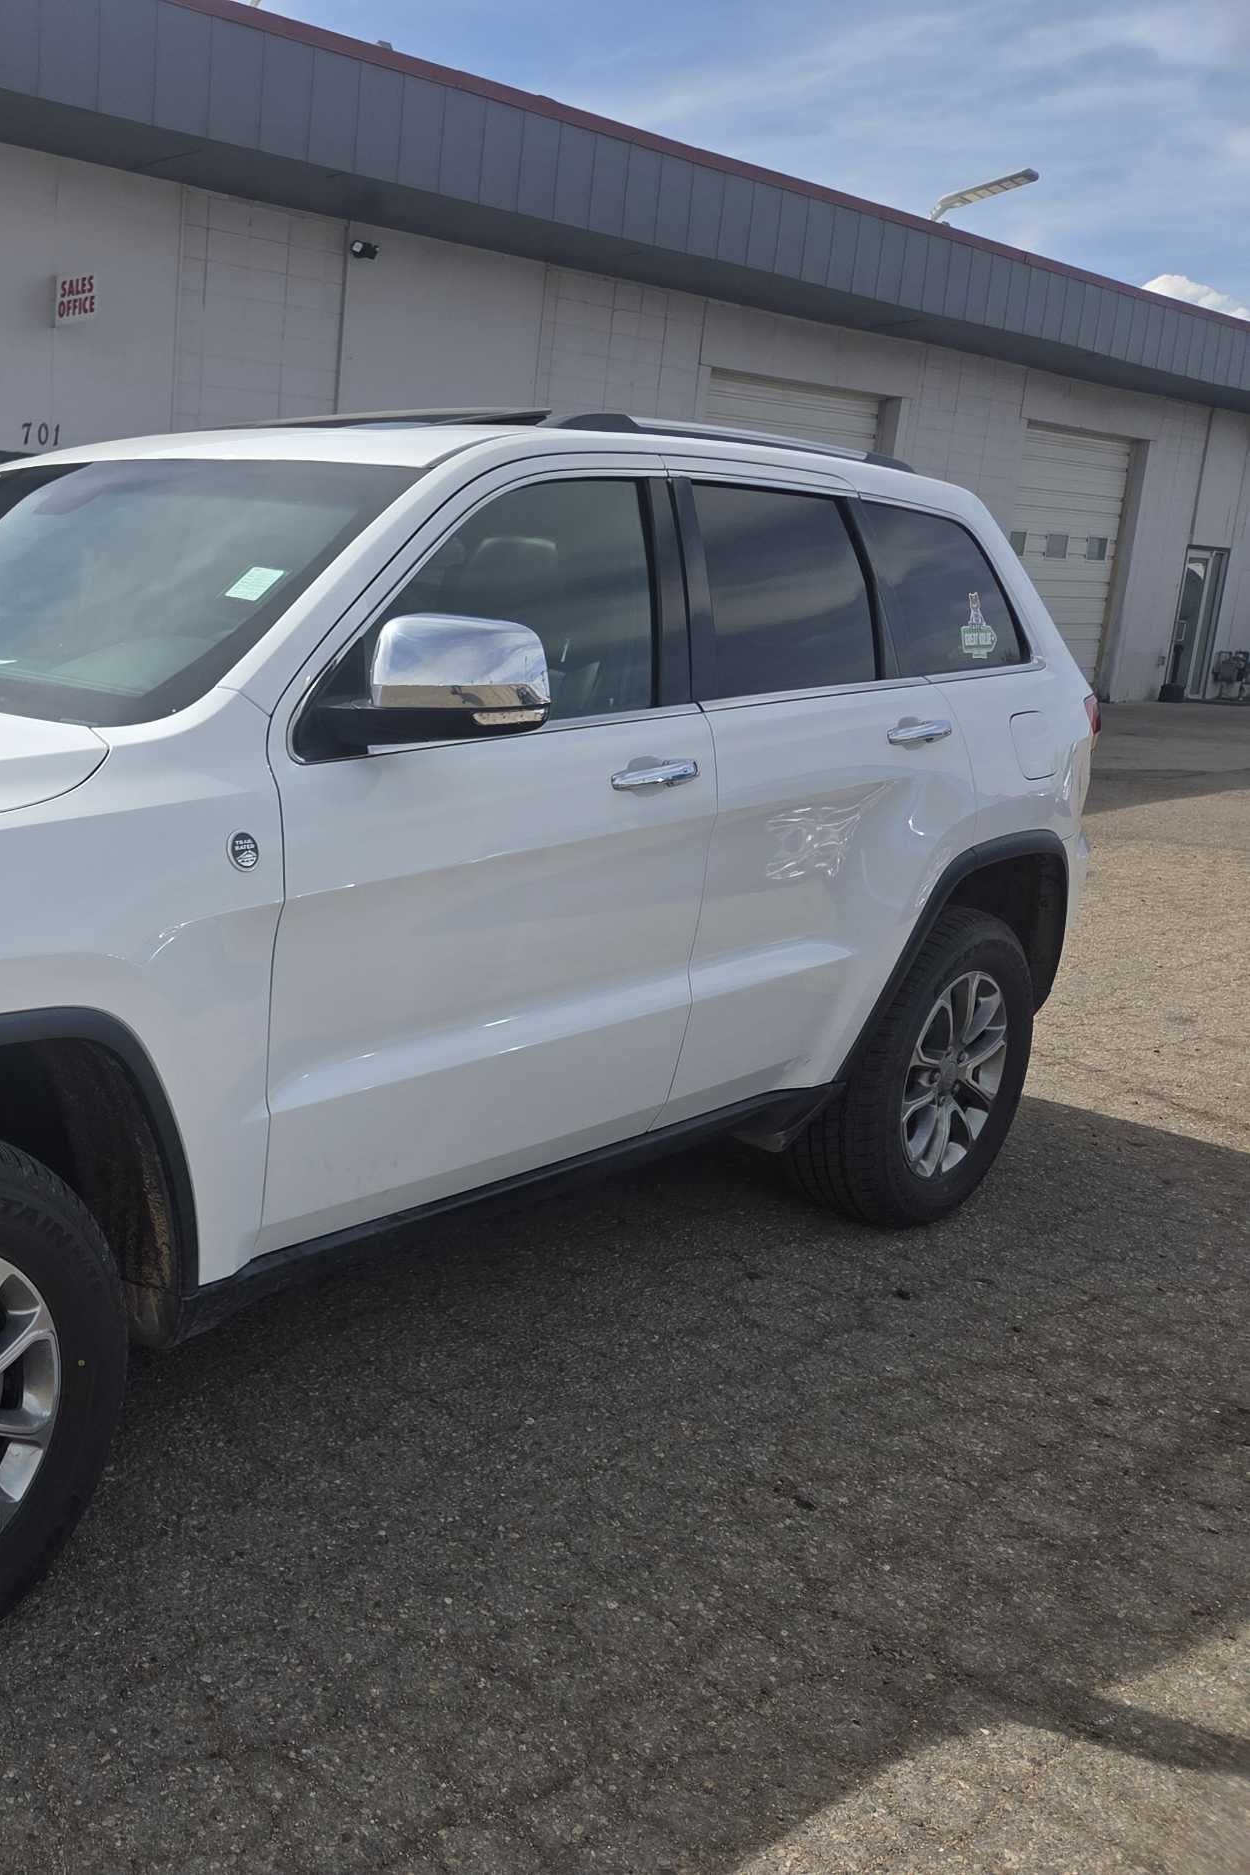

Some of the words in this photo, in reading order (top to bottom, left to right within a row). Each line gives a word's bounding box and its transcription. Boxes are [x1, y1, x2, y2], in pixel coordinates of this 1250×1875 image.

[60, 275, 94, 298] SALES
[58, 295, 95, 319] OFFICE
[21, 422, 61, 447] 701
